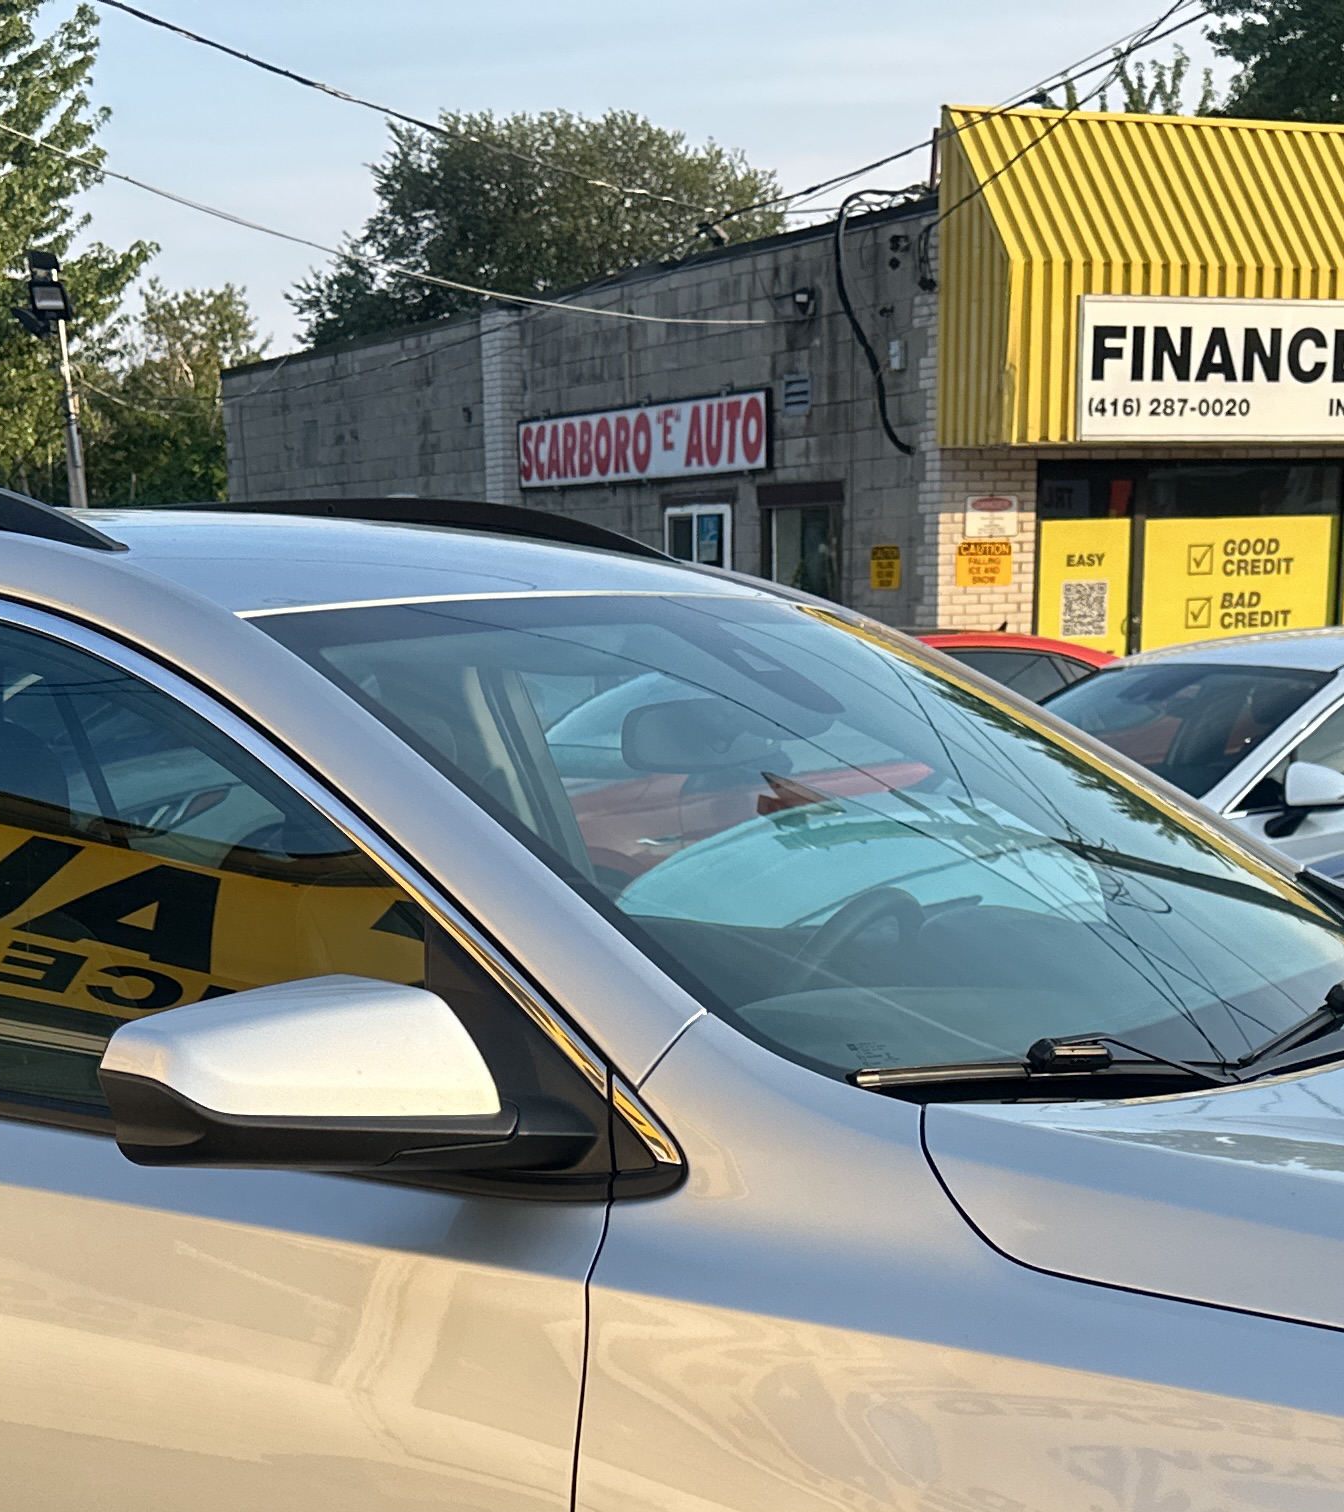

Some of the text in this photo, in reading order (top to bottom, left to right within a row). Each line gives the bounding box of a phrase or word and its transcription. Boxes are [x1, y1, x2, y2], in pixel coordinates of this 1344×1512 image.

[1087, 398, 1251, 418] (416) 287-0020
[521, 411, 653, 482] SCARBORO
[684, 397, 764, 468] AUTO
[960, 543, 1010, 555] CAUTION
[1222, 538, 1280, 557] GOOD
[1065, 552, 1106, 568] EASY
[1222, 557, 1295, 577] CREDIT
[1219, 591, 1262, 610] BAD
[1219, 610, 1292, 630] CREDIT
